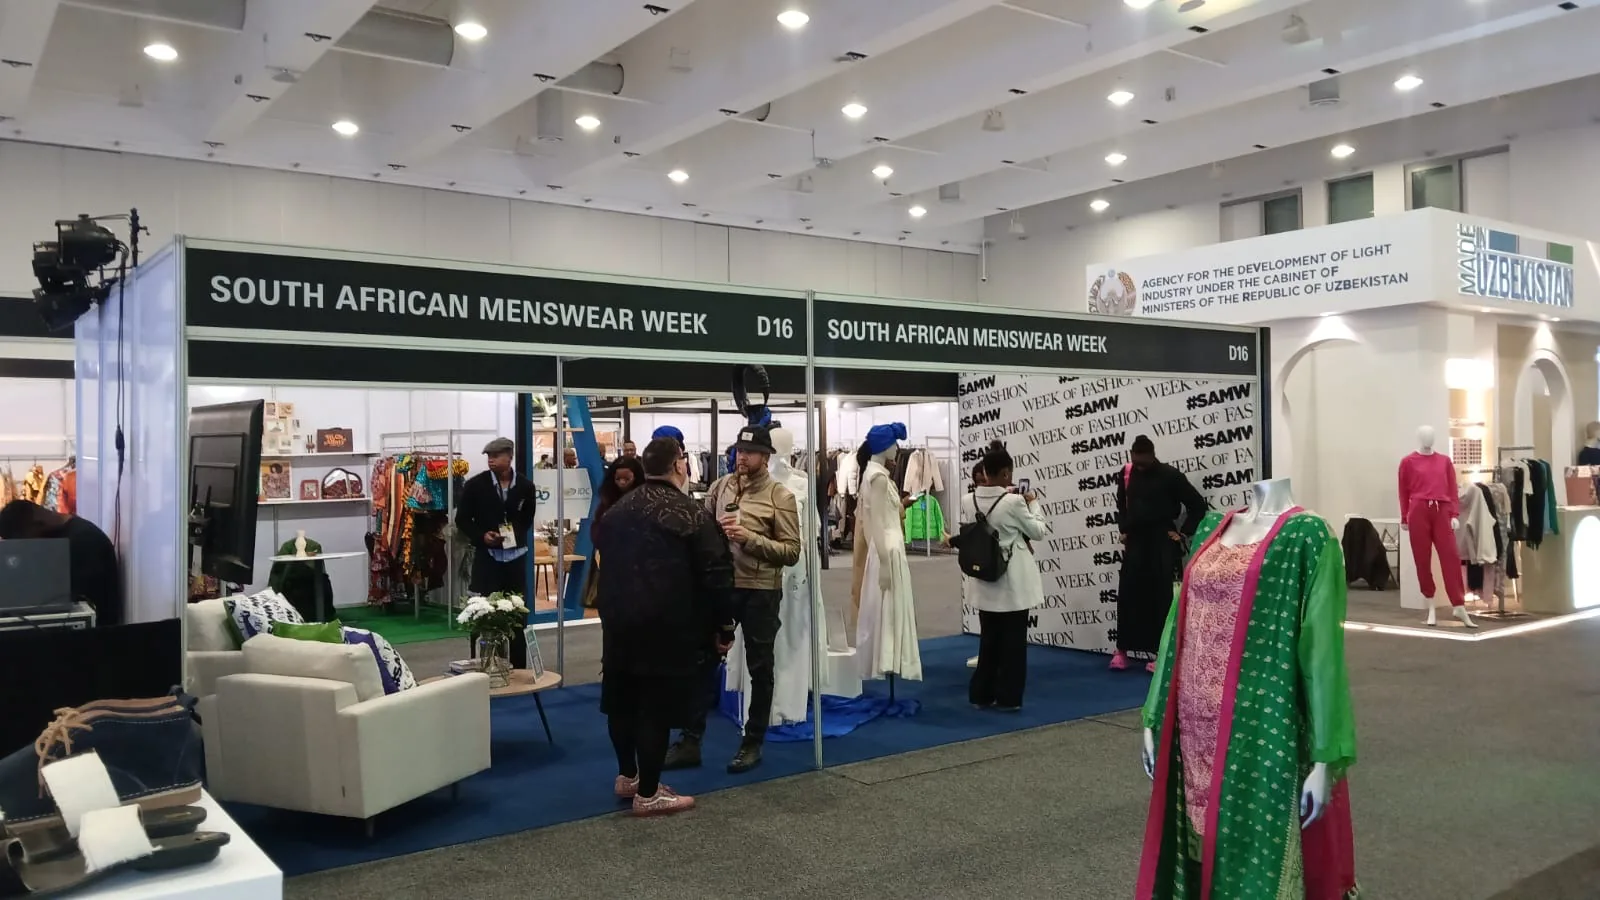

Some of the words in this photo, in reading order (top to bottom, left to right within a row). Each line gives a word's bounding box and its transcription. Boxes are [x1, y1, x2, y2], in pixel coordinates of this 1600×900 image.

[1476, 226, 1489, 250] IN
[1142, 274, 1184, 289] AGENCY
[1187, 270, 1209, 282] FOR
[1212, 266, 1234, 278] THE
[1237, 253, 1327, 275] DEVELOPMENT
[1330, 250, 1348, 262] OF
[1353, 243, 1391, 259] LIGHT
[1458, 223, 1476, 294] MADE
[1142, 286, 1193, 301] INDUSTRY
[1196, 281, 1234, 294] UNDER
[1238, 277, 1260, 289] THE
[1263, 270, 1317, 285] CABINET
[1320, 266, 1339, 278] OF
[1476, 251, 1574, 307] UZBEKISTAN
[1142, 299, 1196, 315] MINISTERS
[1198, 297, 1214, 307] OF
[1217, 293, 1239, 305] THE
[1242, 286, 1300, 302] REPUBLIC
[1304, 283, 1321, 295] OF
[1325, 272, 1408, 292] UZBEKISTAN
[210, 275, 325, 309] SOUTH
[335, 284, 469, 319] AFRICAN
[479, 296, 634, 331] MENSWEAR
[640, 309, 709, 335] WEEK
[757, 315, 794, 339] D16
[827, 318, 890, 342] SOUTH
[894, 323, 969, 346] AFRICAN
[972, 327, 1063, 351] MENSWEAR
[1066, 333, 1108, 354] WEEK
[1228, 345, 1249, 362] D16
[962, 401, 974, 410] OF
[977, 382, 1028, 407] FASHION
[1022, 391, 1061, 412] WEEK
[1063, 388, 1078, 400] OF
[1065, 395, 1119, 420] #SAMW
[1186, 383, 1251, 410] #SAMW
[968, 432, 980, 443] OF
[983, 417, 1034, 440] FASHION
[1028, 426, 1067, 447] WEEK
[1070, 423, 1084, 435] OF
[1088, 407, 1149, 433] FASHION
[1152, 415, 1200, 436] WEEK
[1203, 411, 1219, 425] OF
[1071, 432, 1125, 455] #SAMW
[1034, 462, 1073, 481] WEEK
[1076, 459, 1090, 471] OF
[1211, 453, 1228, 466] OF
[1078, 472, 1120, 491] #SAM
[1041, 498, 1080, 517] WEEK
[1083, 495, 1097, 508] OF
[1220, 493, 1237, 507] OF
[1048, 536, 1089, 553] WEEK
[1091, 533, 1105, 546] OF
[1055, 571, 1096, 589] WEEK
[1099, 571, 1113, 583] OF
[1061, 610, 1102, 625] WEEK
